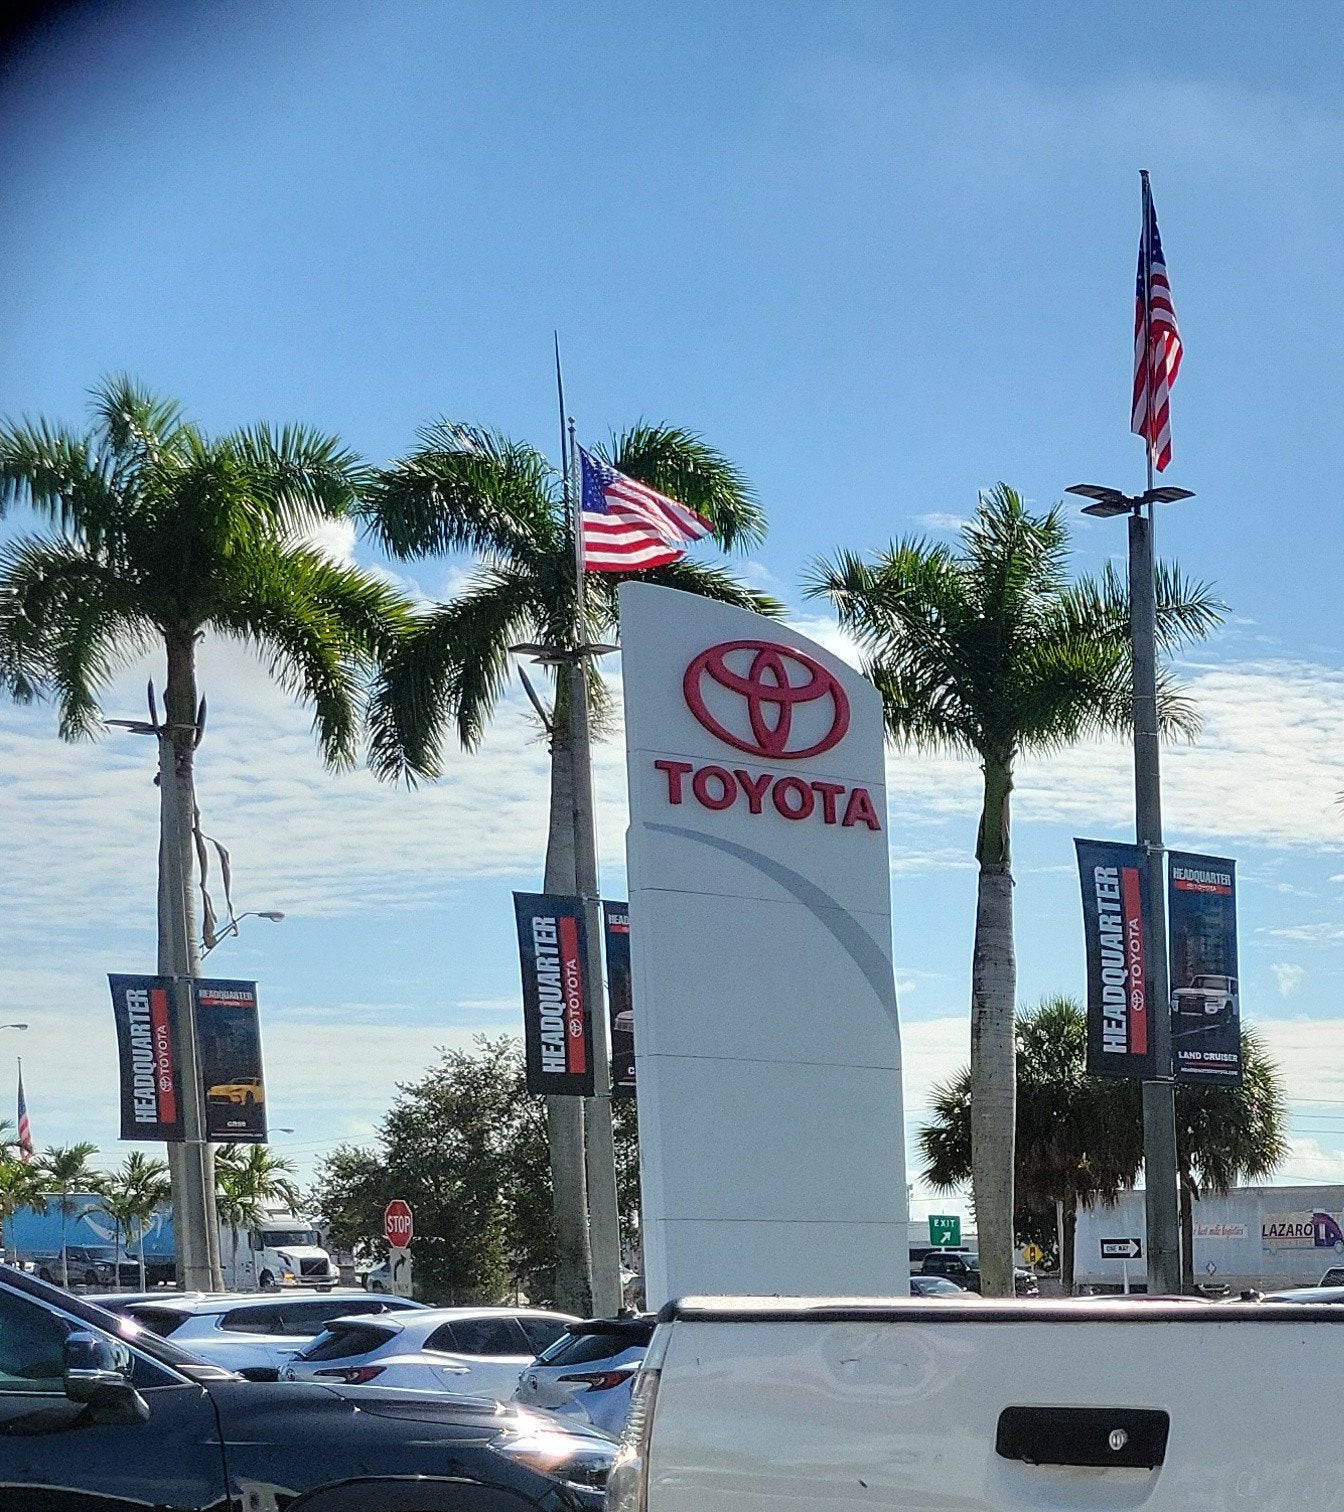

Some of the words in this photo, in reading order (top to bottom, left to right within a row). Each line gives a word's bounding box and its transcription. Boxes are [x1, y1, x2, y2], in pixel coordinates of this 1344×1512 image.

[654, 759, 882, 831] TOYOTA
[1172, 867, 1232, 886] HEADQUARTER
[1094, 866, 1128, 1054] HEADQUARTER
[1128, 918, 1143, 986] TOYOTA
[532, 916, 567, 1074] HEADQUARTER
[566, 959, 581, 1018] TOYOTA
[126, 989, 158, 1124] HEADQUARTER
[156, 1025, 172, 1075] TOYOTA
[1178, 1050, 1202, 1060] LAND
[1203, 1052, 1238, 1062] CRUISER
[387, 1215, 411, 1233] STOP
[933, 1219, 955, 1228] EXIT
[1262, 1223, 1314, 1237] LAZARO
